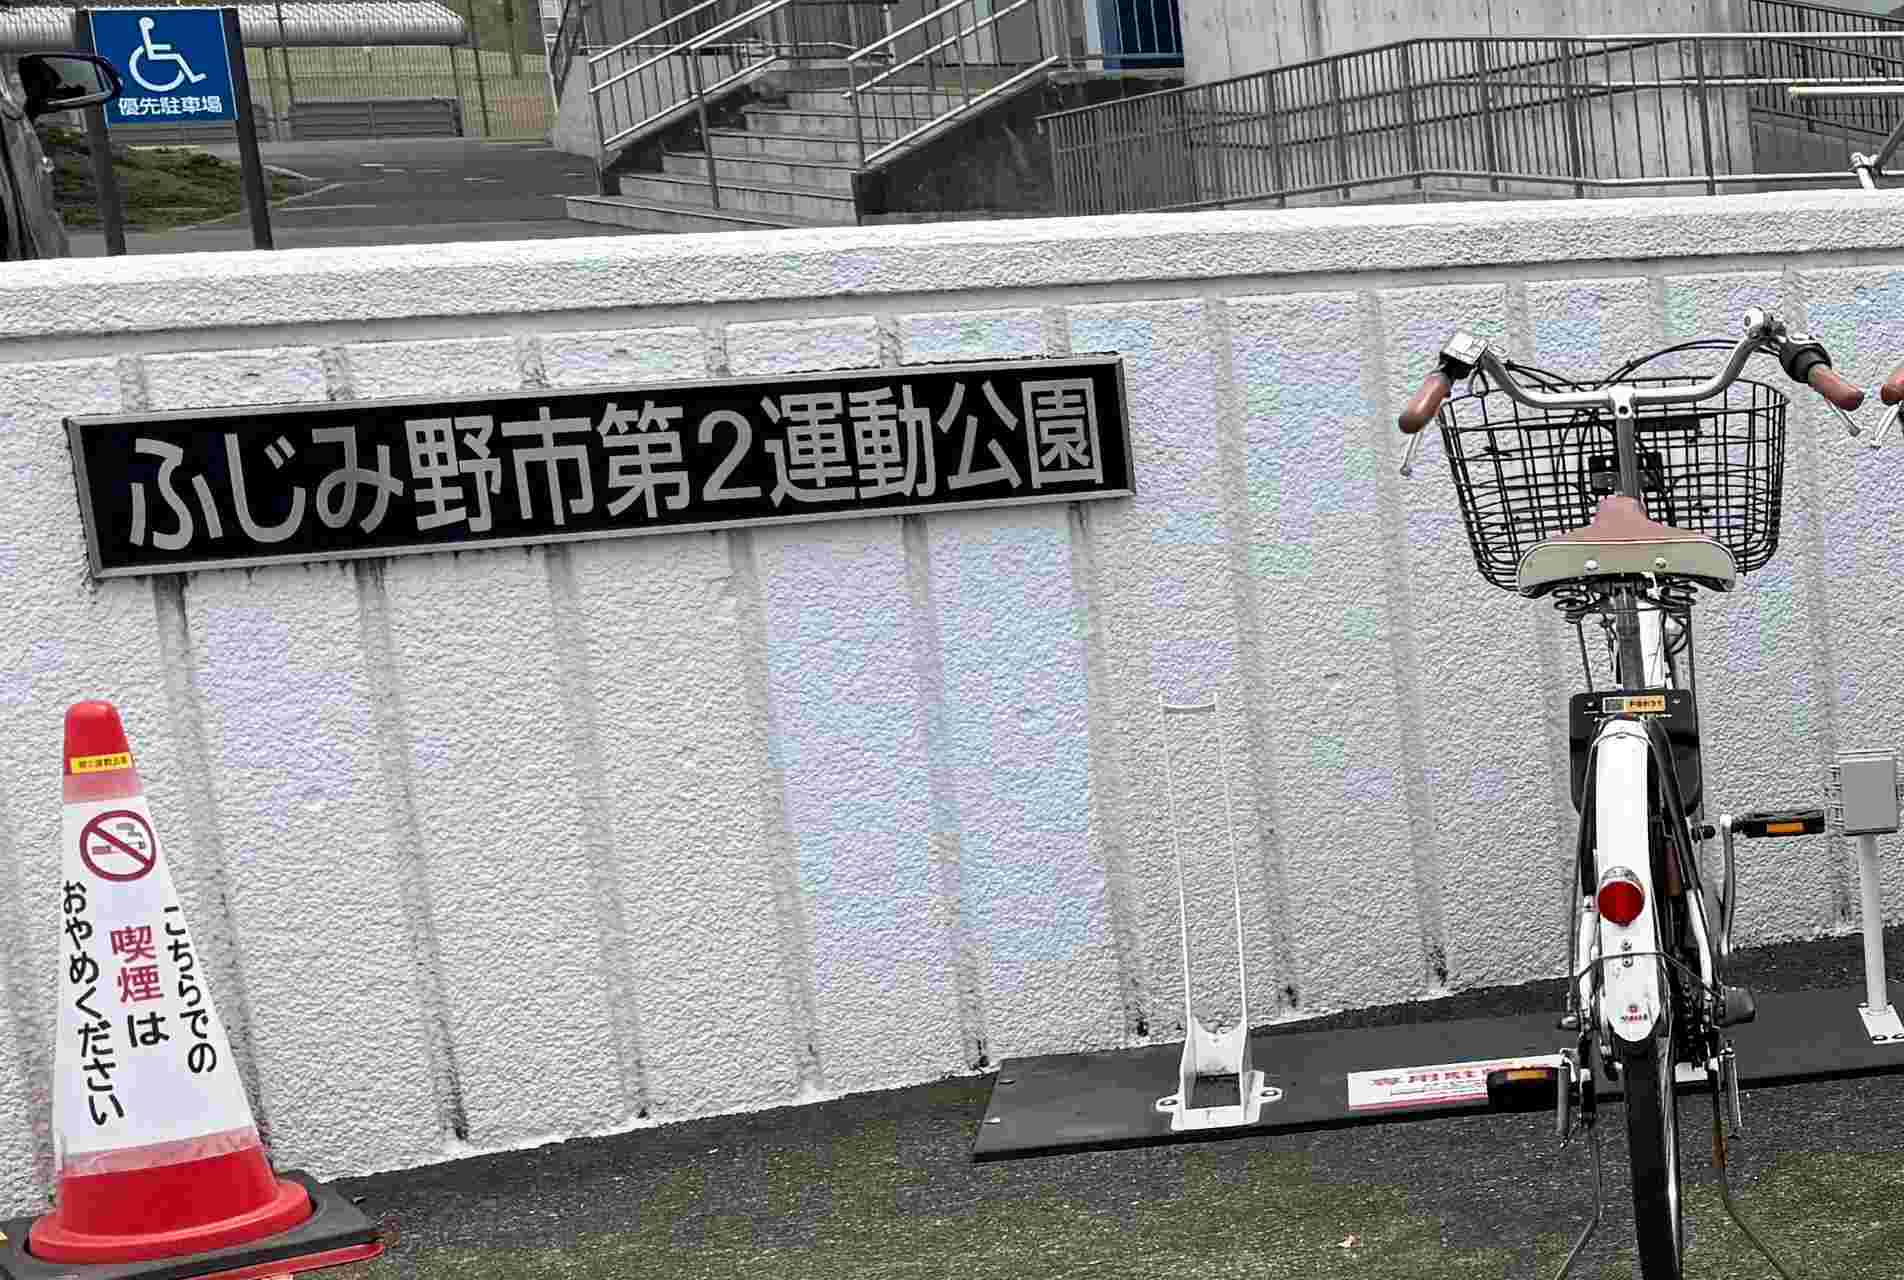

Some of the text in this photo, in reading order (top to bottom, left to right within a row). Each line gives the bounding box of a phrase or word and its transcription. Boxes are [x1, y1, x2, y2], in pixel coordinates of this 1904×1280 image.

[117, 95, 223, 116] 優先駐車場
[127, 376, 1106, 551] ふじみ野市第2運動公園
[63, 880, 126, 1126] おやめください
[110, 925, 170, 1048] 喫煙は
[164, 905, 217, 1074] こちらでの
